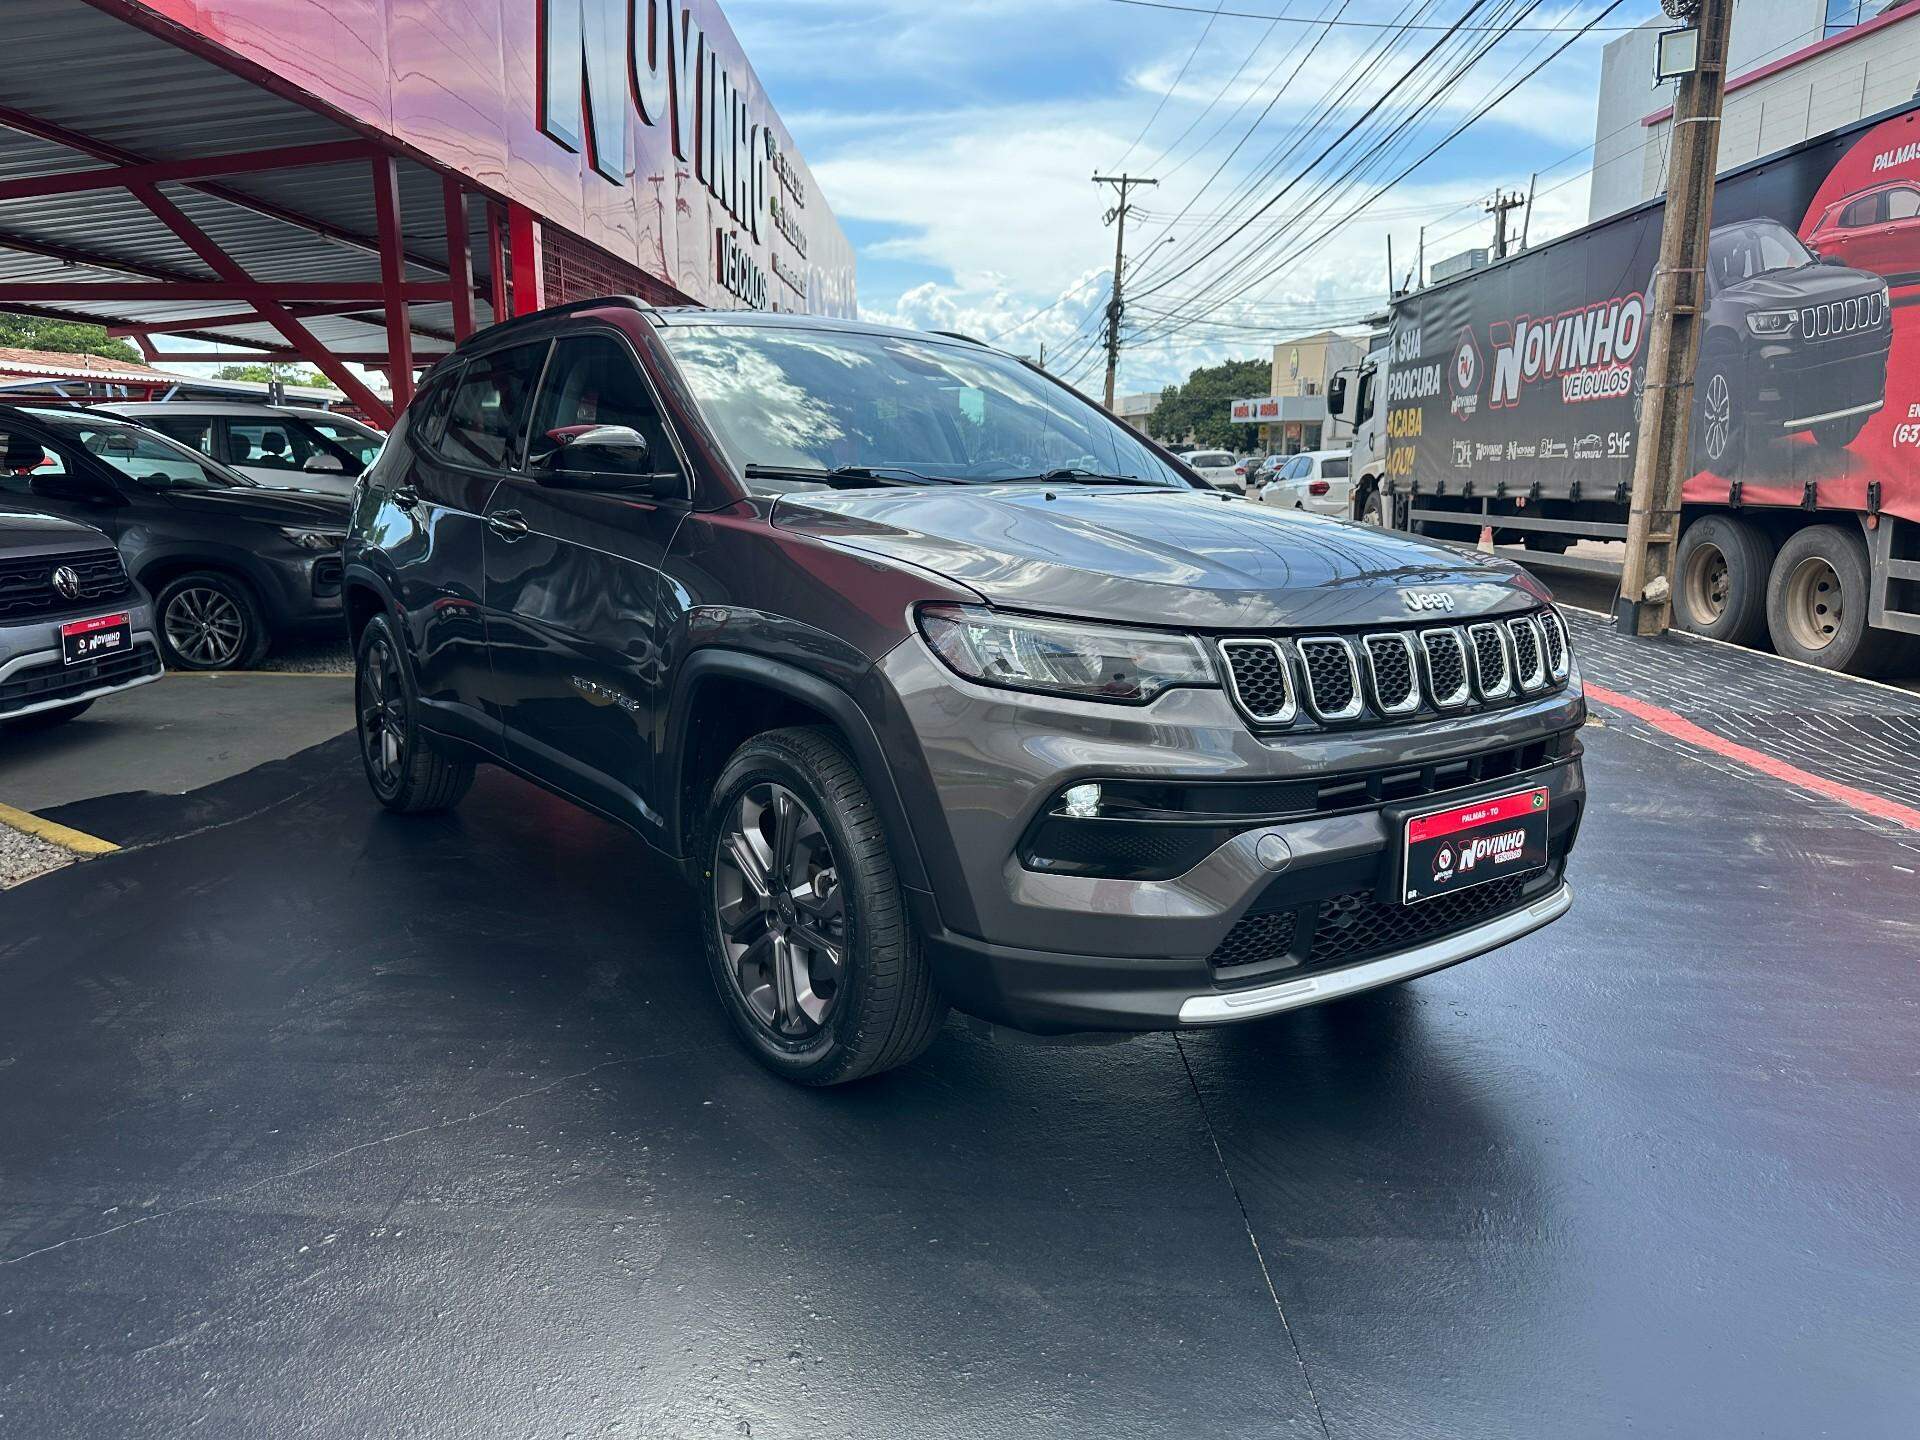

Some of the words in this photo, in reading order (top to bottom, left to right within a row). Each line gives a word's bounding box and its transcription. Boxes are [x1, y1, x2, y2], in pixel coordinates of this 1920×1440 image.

[1399, 327, 1421, 362] SUA
[1387, 363, 1441, 400] PROCURA
[1563, 367, 1632, 401] VEÍCULOS
[1386, 407, 1422, 438] ACABA
[1406, 590, 1455, 613] Jeep
[1461, 810, 1487, 823] PALMAS
[1490, 807, 1499, 816] TO
